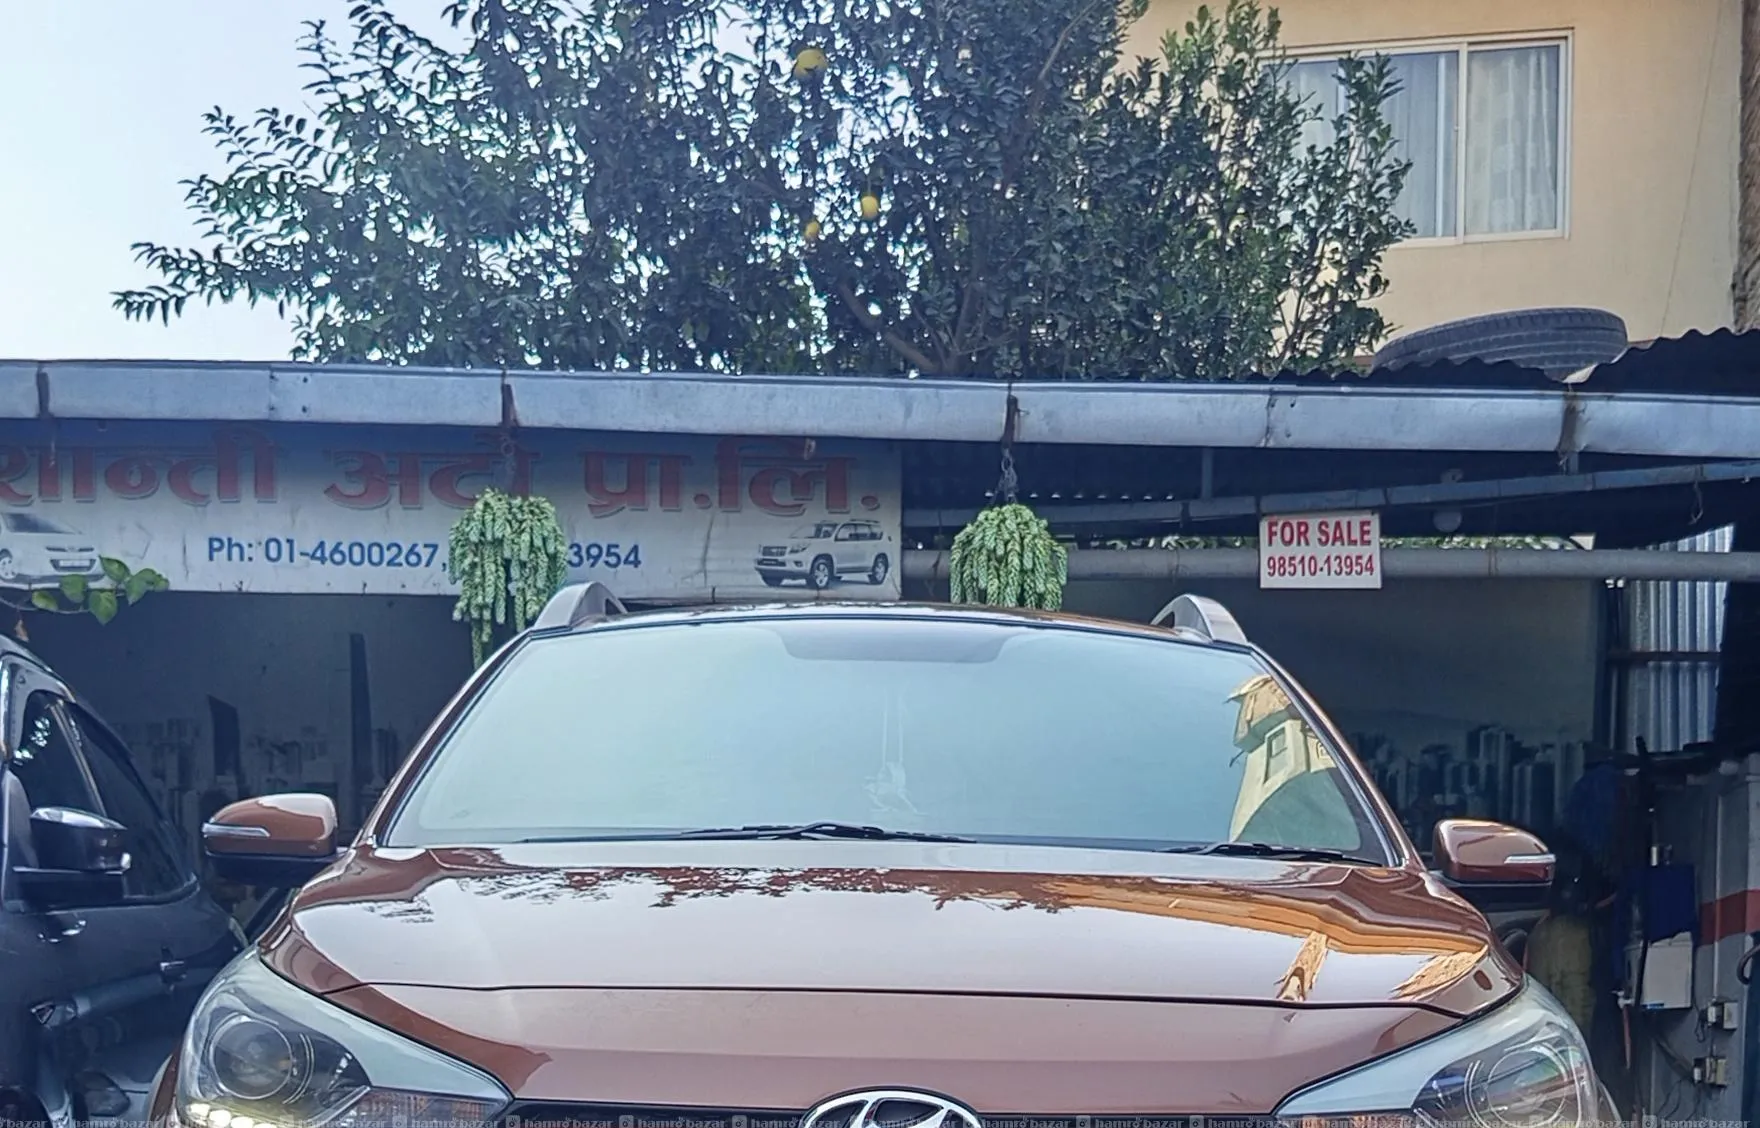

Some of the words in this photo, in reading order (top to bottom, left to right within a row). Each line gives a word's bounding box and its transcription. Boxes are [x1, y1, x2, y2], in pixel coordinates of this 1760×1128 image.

[1267, 519, 1310, 547] FOR
[1317, 519, 1372, 547] SALE
[208, 537, 254, 562] Ph:
[265, 537, 448, 571] 01-4600267,
[1267, 553, 1375, 577] 98510-13954
